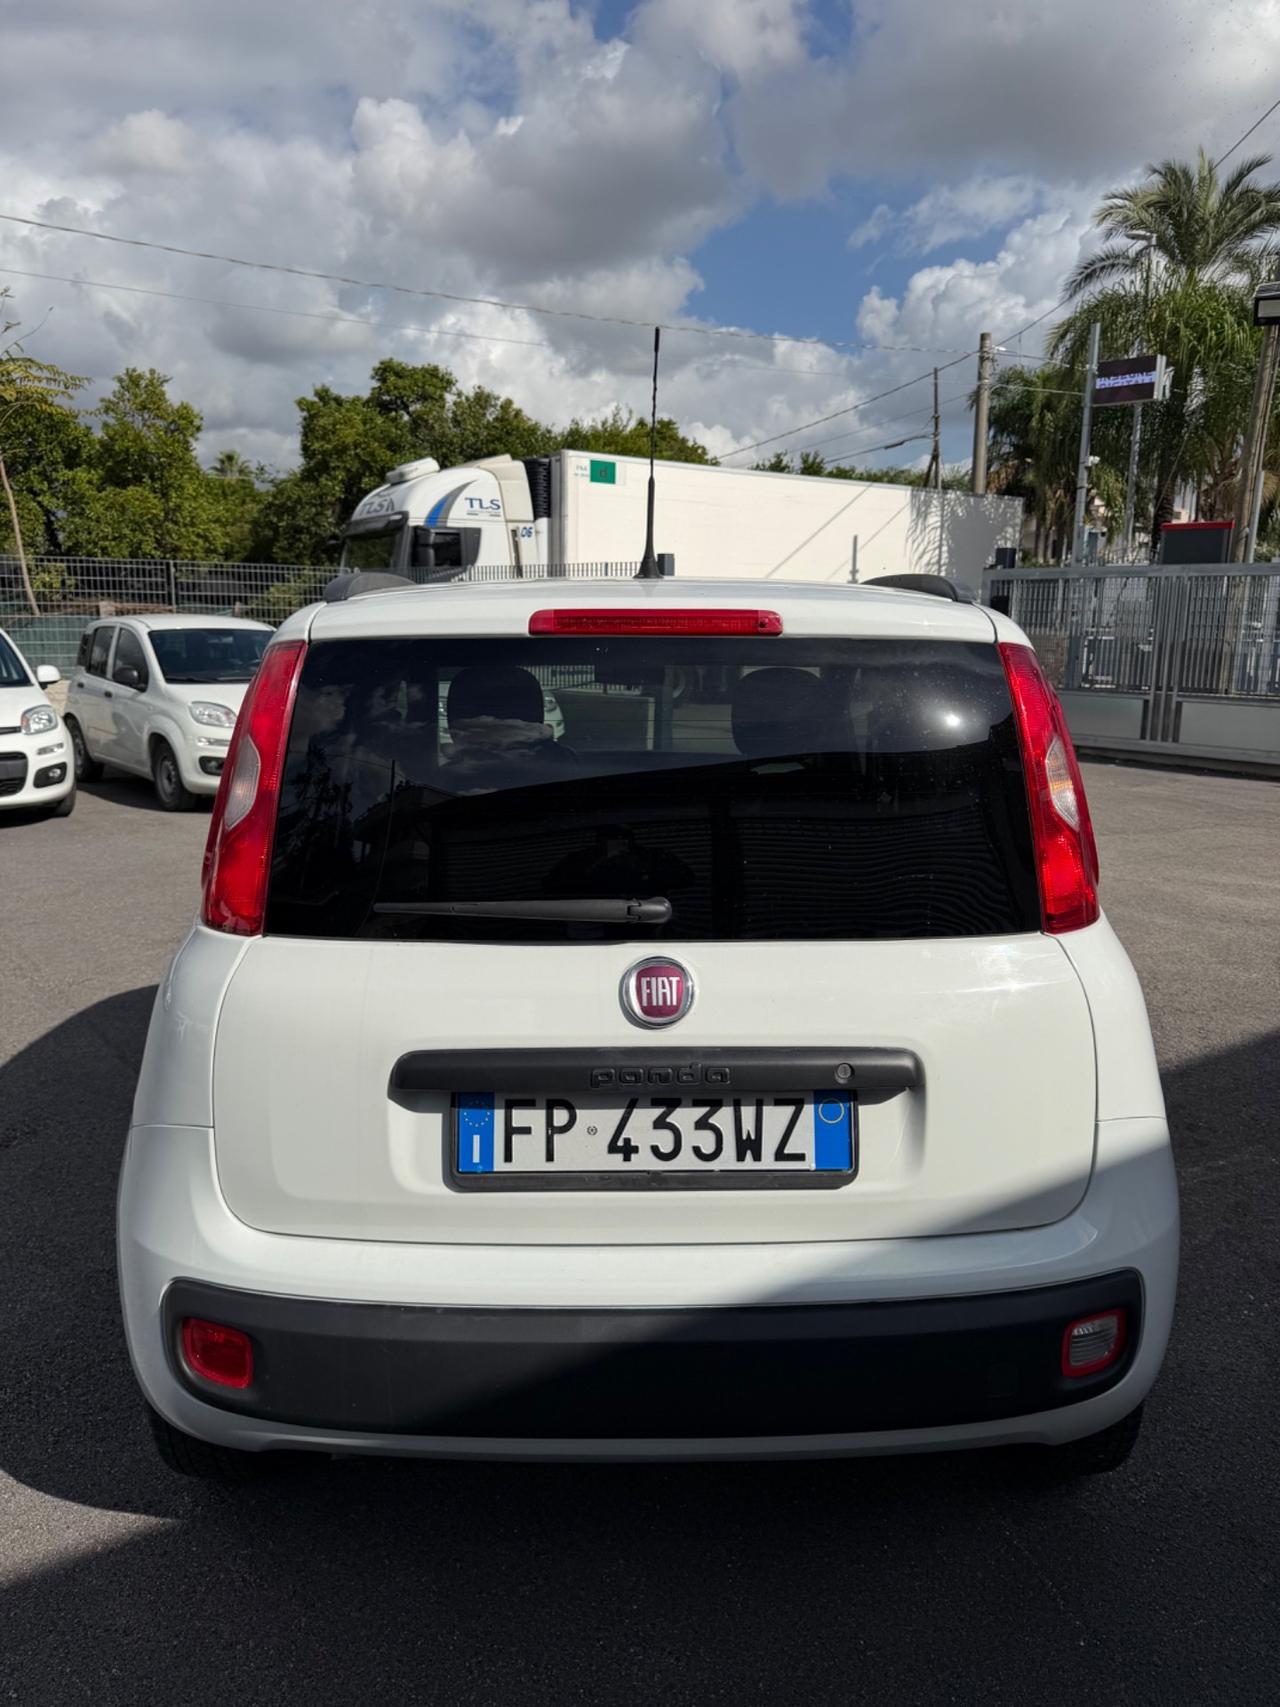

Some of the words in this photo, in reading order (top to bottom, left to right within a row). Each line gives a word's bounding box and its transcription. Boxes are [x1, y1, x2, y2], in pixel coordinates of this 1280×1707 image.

[465, 496, 501, 511] TLS
[641, 976, 680, 1007] FIAT
[590, 1063, 731, 1088] panda
[503, 1098, 577, 1163] FP
[607, 1098, 806, 1163] 433WZ
